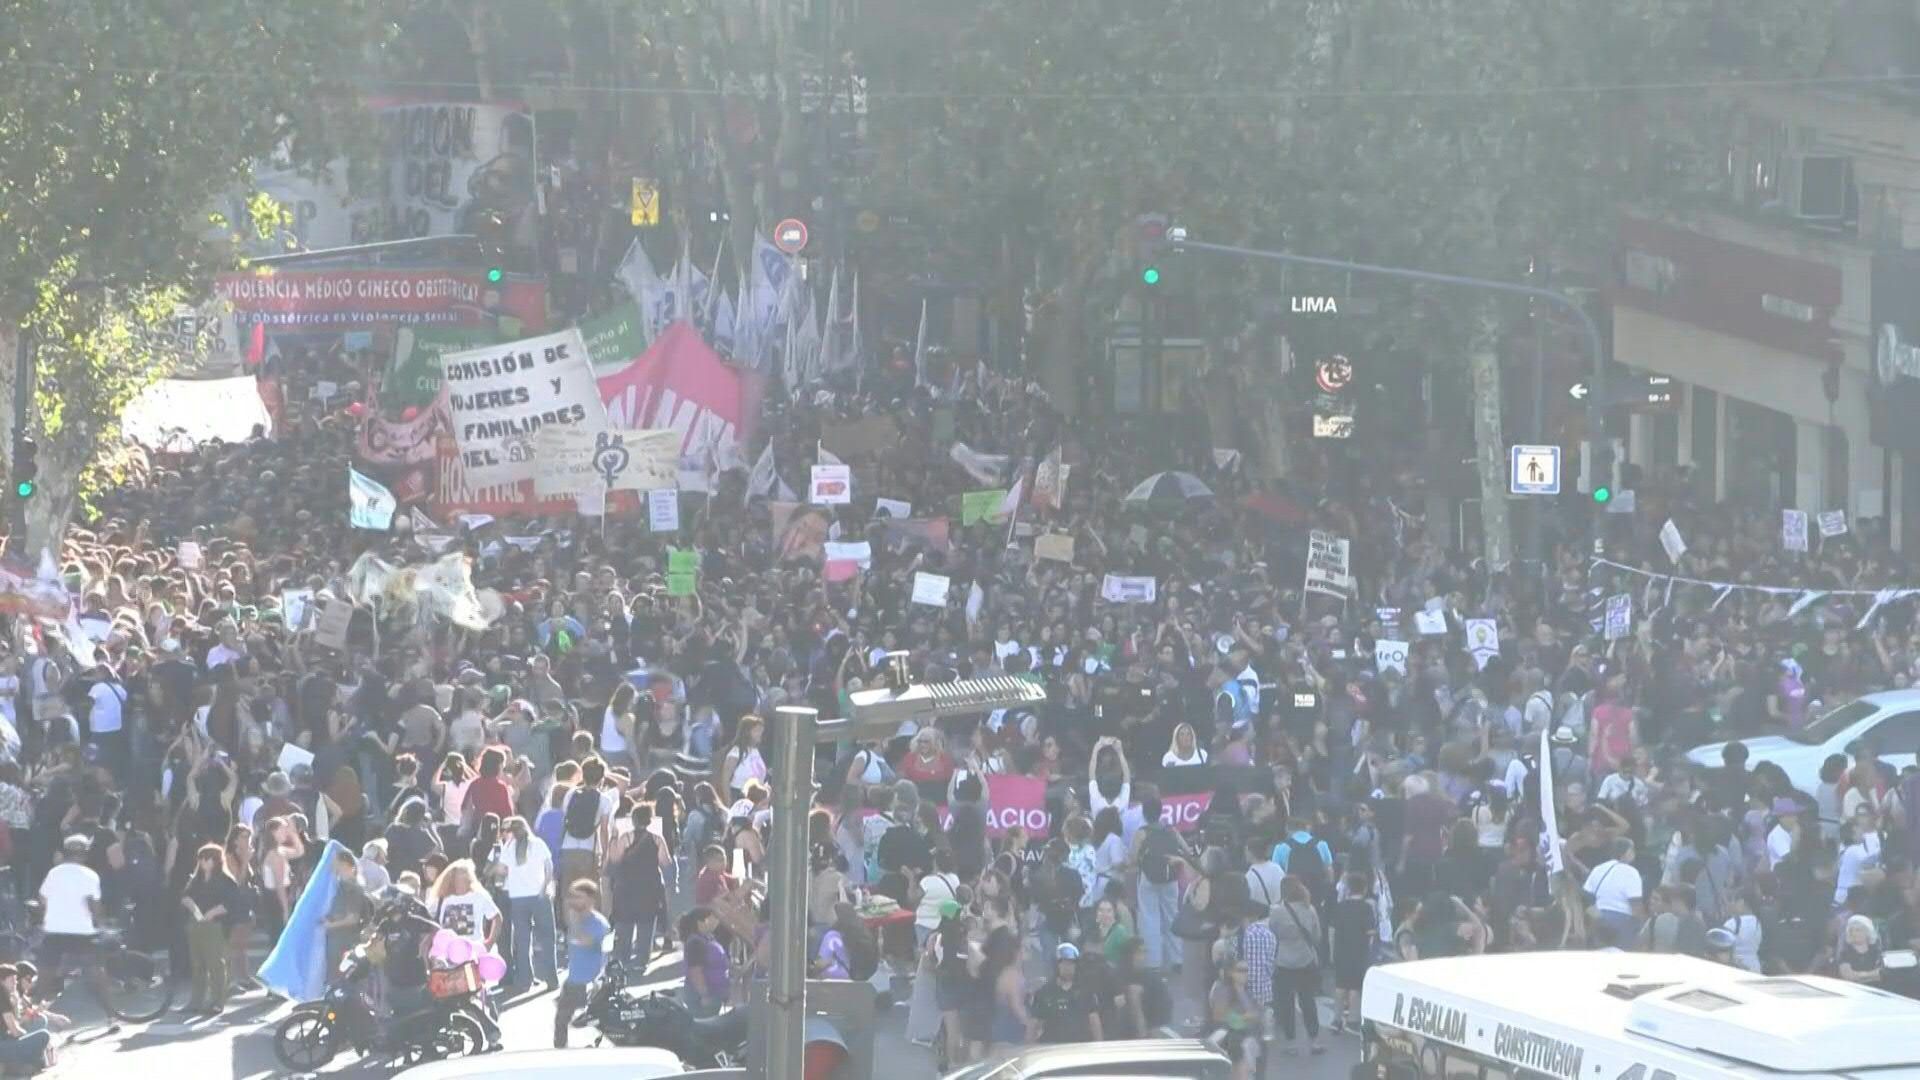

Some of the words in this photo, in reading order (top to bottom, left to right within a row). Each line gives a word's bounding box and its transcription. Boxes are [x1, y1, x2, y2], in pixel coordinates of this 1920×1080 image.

[227, 280, 300, 299] VIOLENCIA
[358, 280, 410, 299] GINECO
[1290, 296, 1338, 313] LIMA
[545, 344, 569, 363] DE
[550, 376, 561, 395] Y
[1408, 996, 1468, 1045] ESCALADA
[1494, 1021, 1585, 1080] CONSTITUCION
